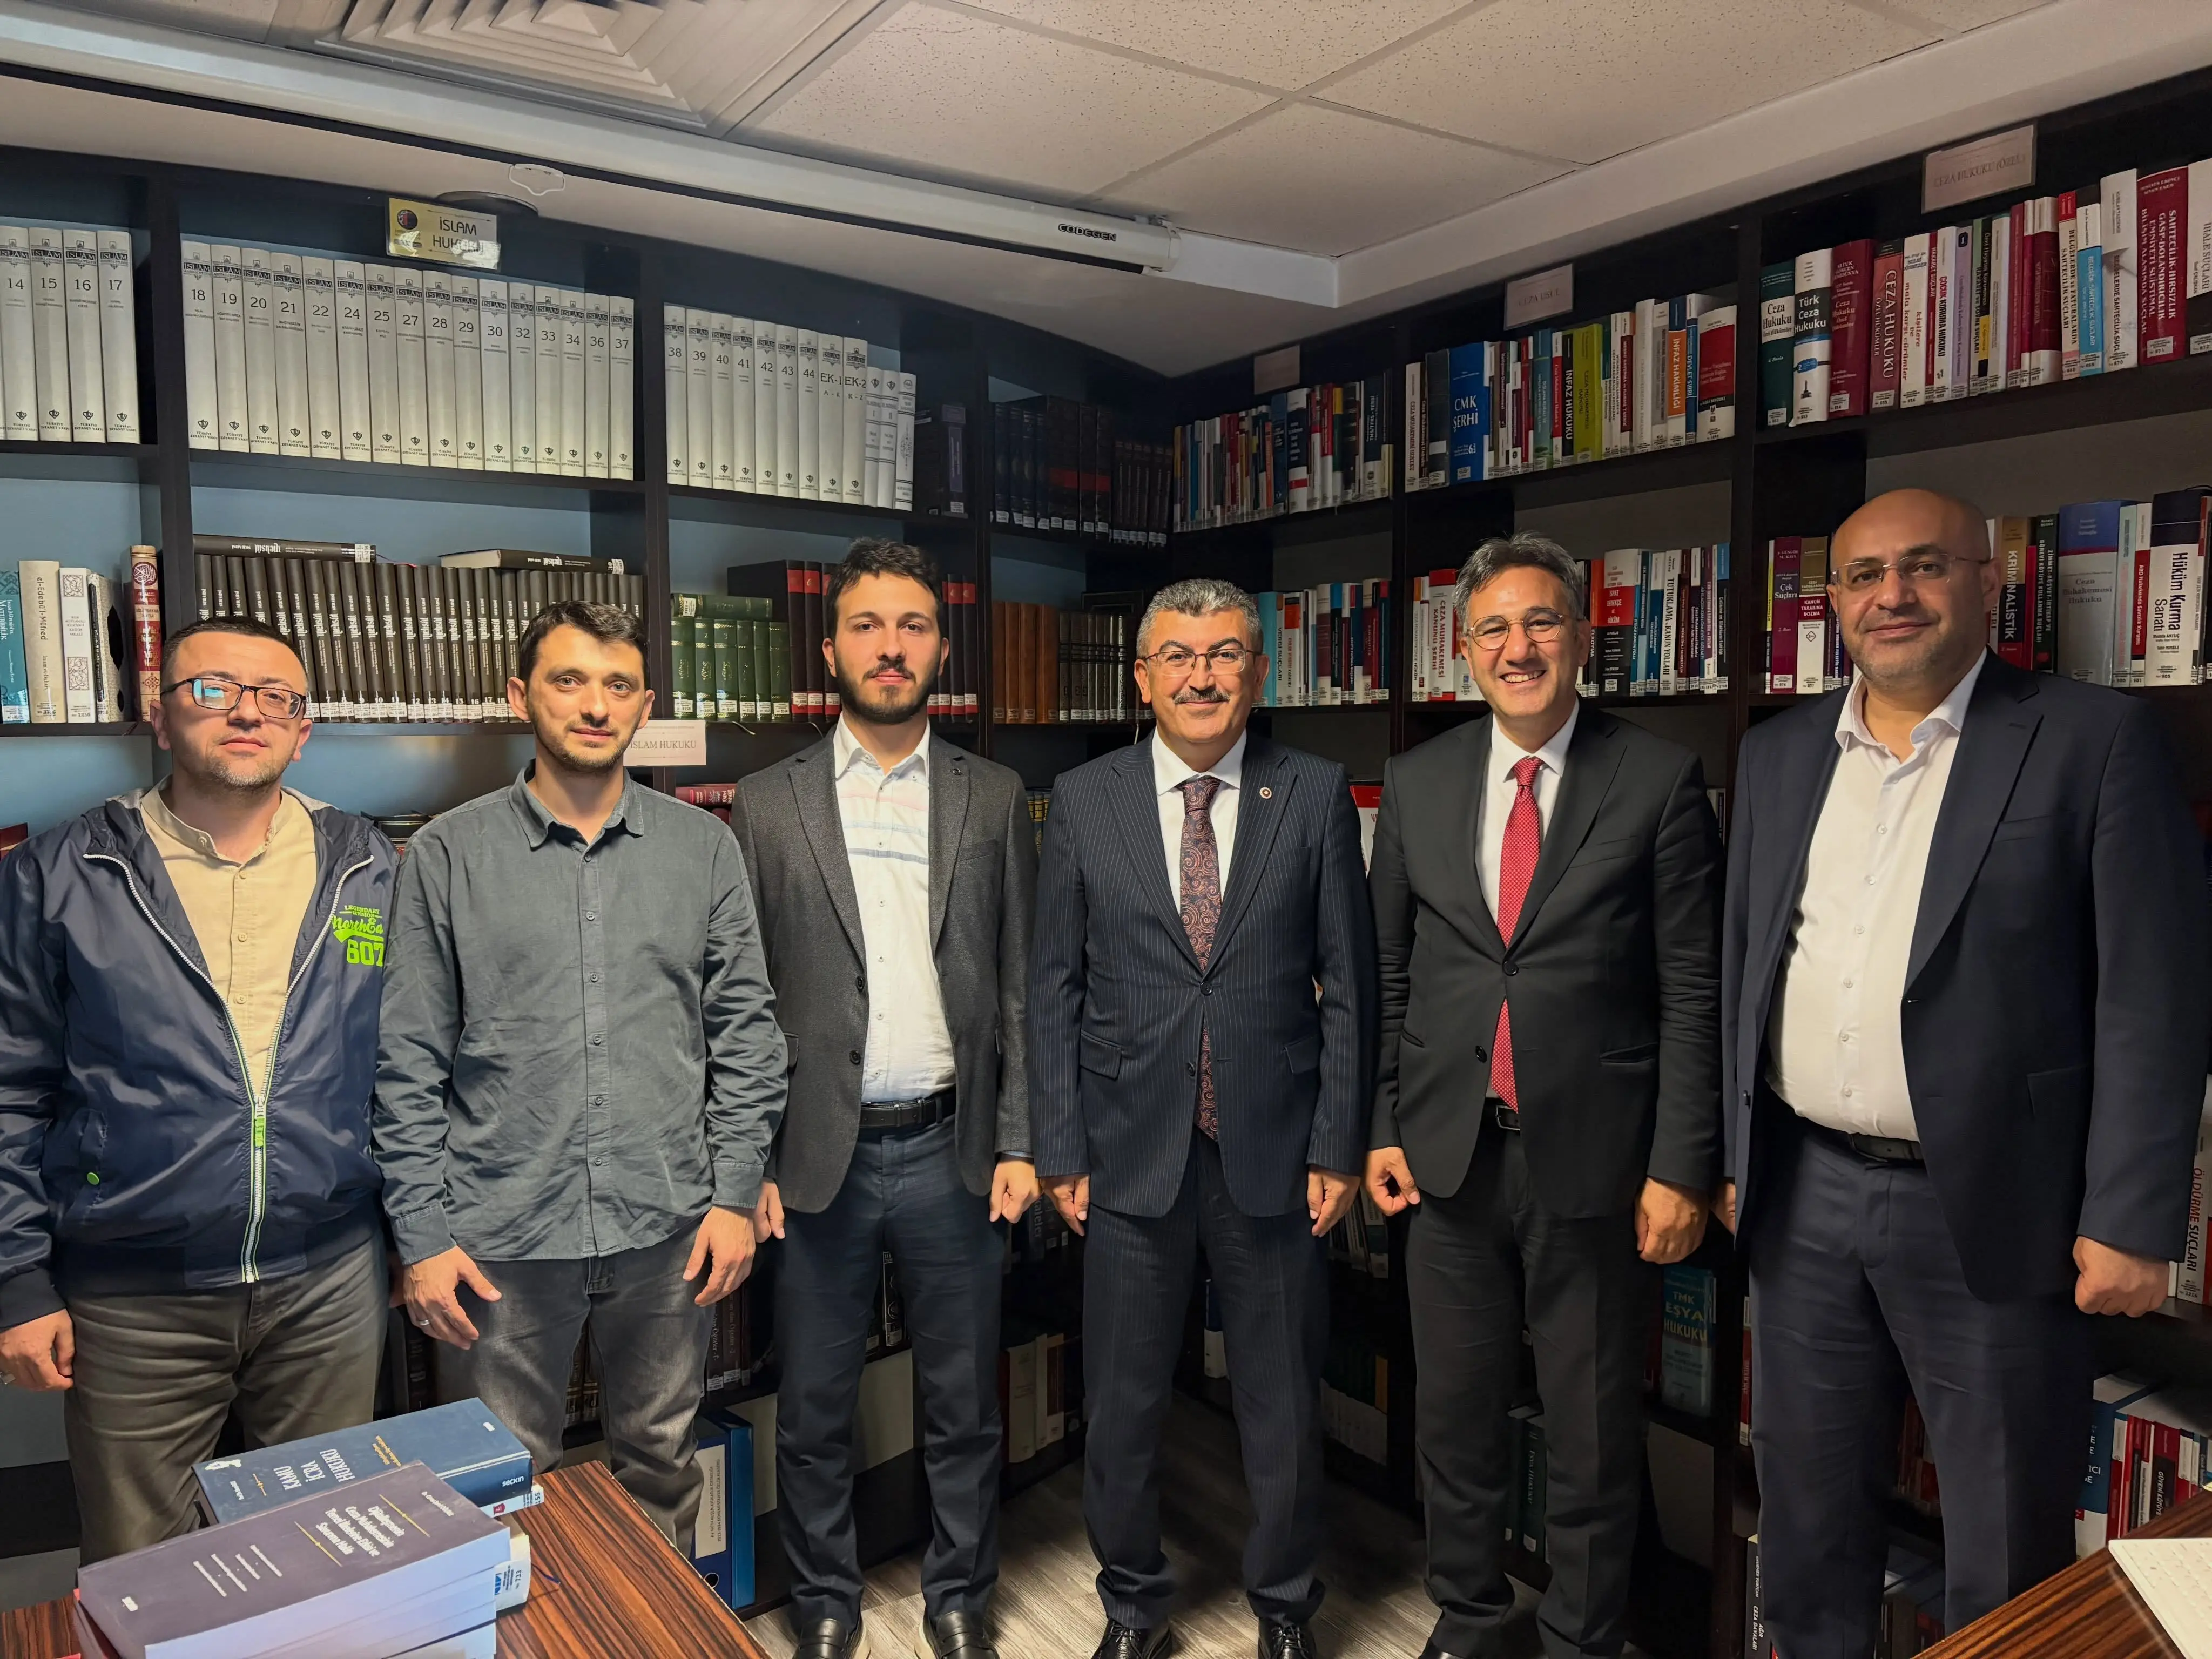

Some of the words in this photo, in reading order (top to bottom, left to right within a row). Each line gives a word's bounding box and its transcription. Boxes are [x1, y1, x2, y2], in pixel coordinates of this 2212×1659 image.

[440, 217, 477, 235] İSLAM
[1058, 224, 1117, 241] CODEGEN
[2202, 252, 2210, 289] SUÇLARI
[8, 278, 24, 289] 14
[41, 278, 57, 289] 15
[75, 279, 91, 291] 16
[109, 280, 123, 291] 17
[1885, 269, 1897, 309] CEZA
[1939, 276, 1947, 298] ÇOCUK
[191, 289, 205, 301] 18
[221, 293, 237, 304] 19
[1799, 295, 1819, 307] Türk
[250, 297, 267, 308] 20
[281, 301, 296, 313] 21
[312, 305, 329, 316] 22
[344, 307, 360, 319] 24
[1768, 304, 1785, 314] Ceza
[1798, 309, 1819, 320] Ceza
[374, 311, 390, 321] 25
[403, 315, 418, 326] 27
[1763, 315, 1792, 329] Hukuku
[432, 318, 448, 329] 28
[459, 322, 474, 333] 29
[1795, 319, 1826, 334] Hukuku
[487, 326, 503, 337] 30
[515, 327, 530, 339] 32
[541, 331, 556, 341] 33
[566, 334, 580, 346] 34
[590, 336, 604, 347] 36
[615, 339, 629, 349] 37
[1883, 313, 1896, 379] HUKUKU
[668, 347, 682, 358] 38
[693, 351, 706, 361] 39
[716, 355, 729, 365] 40
[738, 359, 750, 369] 41
[761, 362, 773, 372] 42
[781, 366, 794, 375] 43
[803, 369, 815, 379] 44
[820, 373, 841, 385] EK-1
[845, 376, 866, 388] EK-2
[1454, 395, 1476, 412] CMK
[1453, 409, 1478, 432] ŞERHİ
[2171, 553, 2188, 591] Hüküm
[1780, 583, 1793, 594] Çek
[1666, 577, 1674, 621] TUTUKLAMA
[1775, 592, 1798, 600] Suçları
[2004, 550, 2018, 640] KRİMİNALİSTİK
[2154, 599, 2167, 631] Sanatı
[2168, 595, 2186, 630] Kurma
[659, 740, 696, 749] HUKUKU
[344, 905, 380, 914] LEGENDARY
[347, 939, 384, 967] 607
[2190, 1167, 2204, 1223] ÖLDÜRME
[2187, 1224, 2200, 1271] SUÇLARI
[1673, 1291, 1694, 1305] TMK
[1665, 1302, 1704, 1321] EŞYA
[1664, 1318, 1707, 1341] HUKUKU
[300, 1460, 326, 1482] İCRA
[320, 1449, 355, 1482] HUKUKU
[274, 1466, 302, 1491] KAMU
[2157, 1471, 2165, 1493] GÜVENİ
